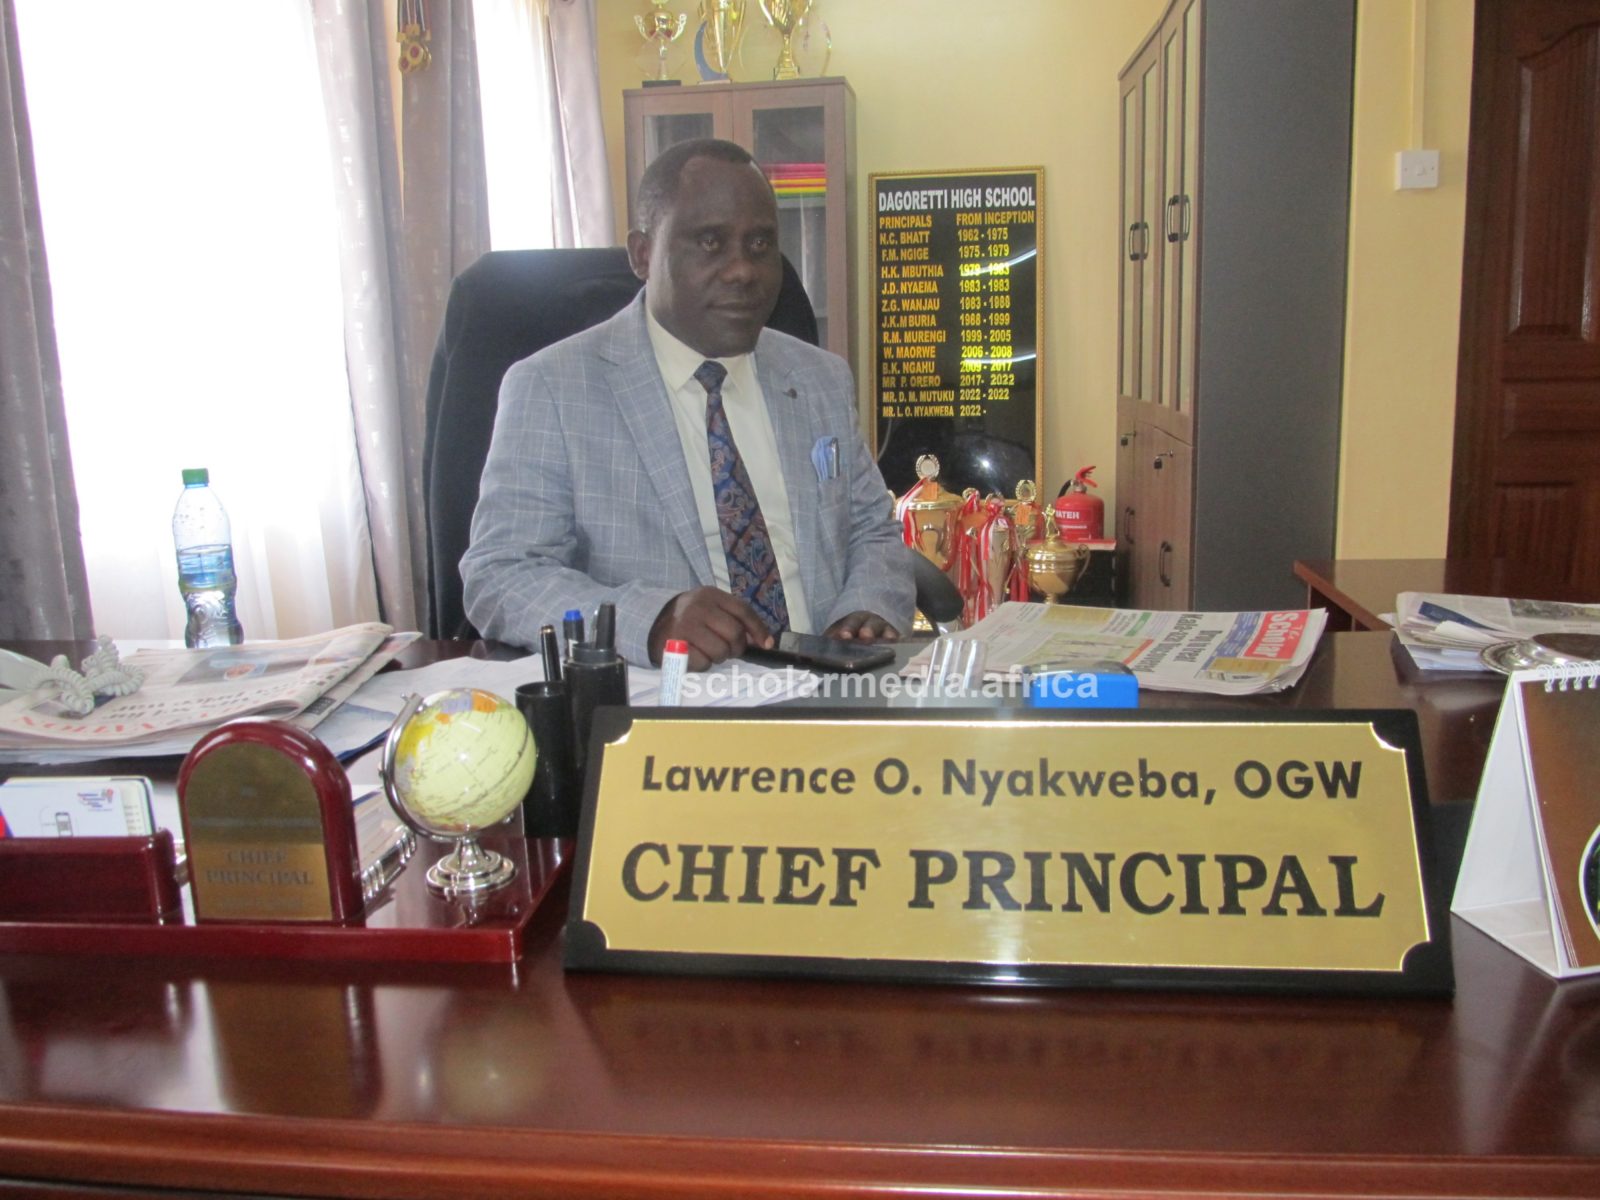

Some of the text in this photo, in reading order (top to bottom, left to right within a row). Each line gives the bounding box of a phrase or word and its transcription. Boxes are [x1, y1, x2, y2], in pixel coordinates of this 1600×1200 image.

[879, 187, 1035, 211] DAGORETTI HIGH SCHOOL
[880, 211, 1034, 229] PRINCIPALS FROM INCEPTION
[880, 232, 898, 245] N.C.
[900, 231, 930, 244] BHATT
[958, 229, 979, 241] 1962
[987, 227, 1008, 240] 1975
[882, 249, 899, 261] F.M.
[901, 248, 929, 260] NGIGE
[959, 245, 980, 258] 1975
[988, 244, 1009, 257] 1979
[882, 266, 900, 278] H.K.
[902, 264, 944, 278] MBUTHIA
[882, 282, 899, 294] J.D.
[901, 281, 938, 294] NYAEMA
[960, 279, 980, 292] 1983
[988, 278, 1009, 292] 1983
[882, 299, 900, 312] Z.G.
[902, 298, 940, 311] WANJAU
[989, 312, 1010, 326] 1999
[883, 331, 901, 343] R.M.
[904, 330, 946, 343] MURENGI
[961, 330, 982, 342] 1999
[990, 330, 1011, 342] 2005
[884, 346, 894, 359] W.
[896, 346, 936, 358] MAORWE
[962, 346, 983, 358] 2006
[990, 346, 1012, 358] 2008
[903, 361, 935, 373] NGAHU
[910, 375, 941, 387] ORERO
[990, 374, 1014, 386] 2022
[883, 391, 897, 403] MR.
[920, 390, 954, 402] MUTUKU
[960, 388, 981, 400] 2022
[988, 388, 1009, 400] 2022
[914, 405, 954, 417] NYAKWEBA
[960, 405, 981, 416] 2022
[1252, 612, 1299, 658] Scholar
[642, 755, 1362, 807] Lawrence O. Nyakweba, OGW
[227, 850, 287, 864] CHIEF
[206, 870, 314, 885] PRINCIPAL
[621, 842, 1386, 918] CHIEF PRINCIPAL
